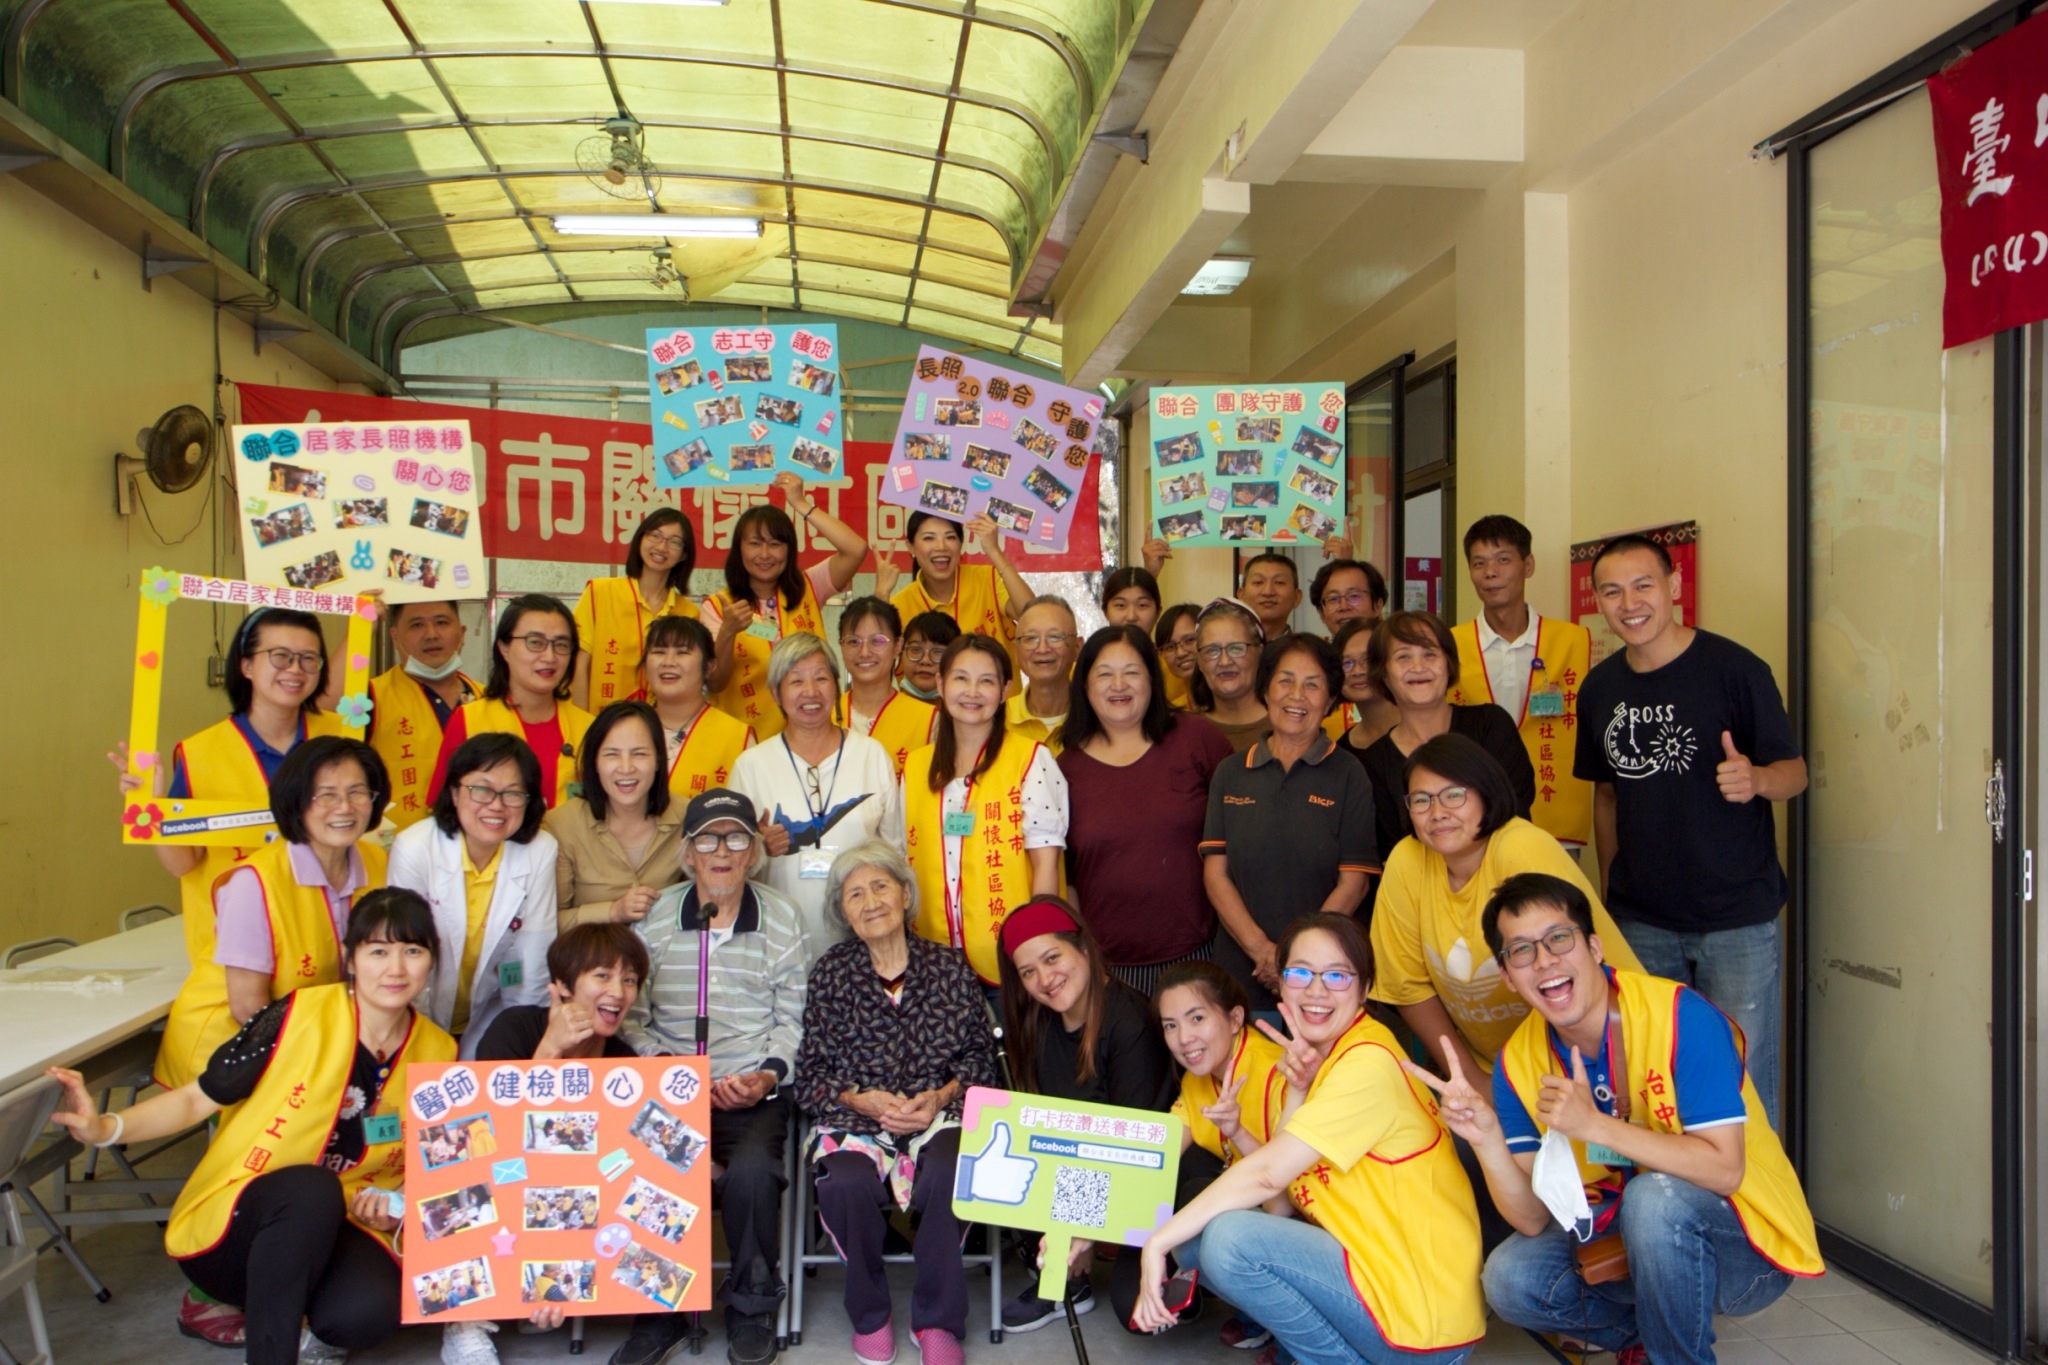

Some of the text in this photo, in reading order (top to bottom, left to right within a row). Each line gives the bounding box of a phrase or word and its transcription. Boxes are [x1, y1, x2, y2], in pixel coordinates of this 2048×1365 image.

[653, 331, 832, 363] 聯合 志工守 護您
[917, 356, 1032, 406] 長照 2.0 聯合
[1157, 391, 1344, 416] 聯合 團隊守護 您
[394, 458, 471, 493] 關心您
[181, 575, 355, 615] 聯合居家長照機構
[736, 642, 761, 719] 志工團隊
[1563, 668, 1577, 731] 台中市
[1629, 704, 1675, 724] ROSS
[397, 717, 421, 812] 志工團隊
[162, 821, 208, 834] facebook
[1007, 785, 1024, 857] 台中市
[983, 802, 1006, 941] 關懷社區協會
[412, 1067, 700, 1120] 醫師 健檢關 心 您
[1021, 1106, 1166, 1143] 打卡按讚送養生粥
[1031, 1138, 1077, 1155] facebook
